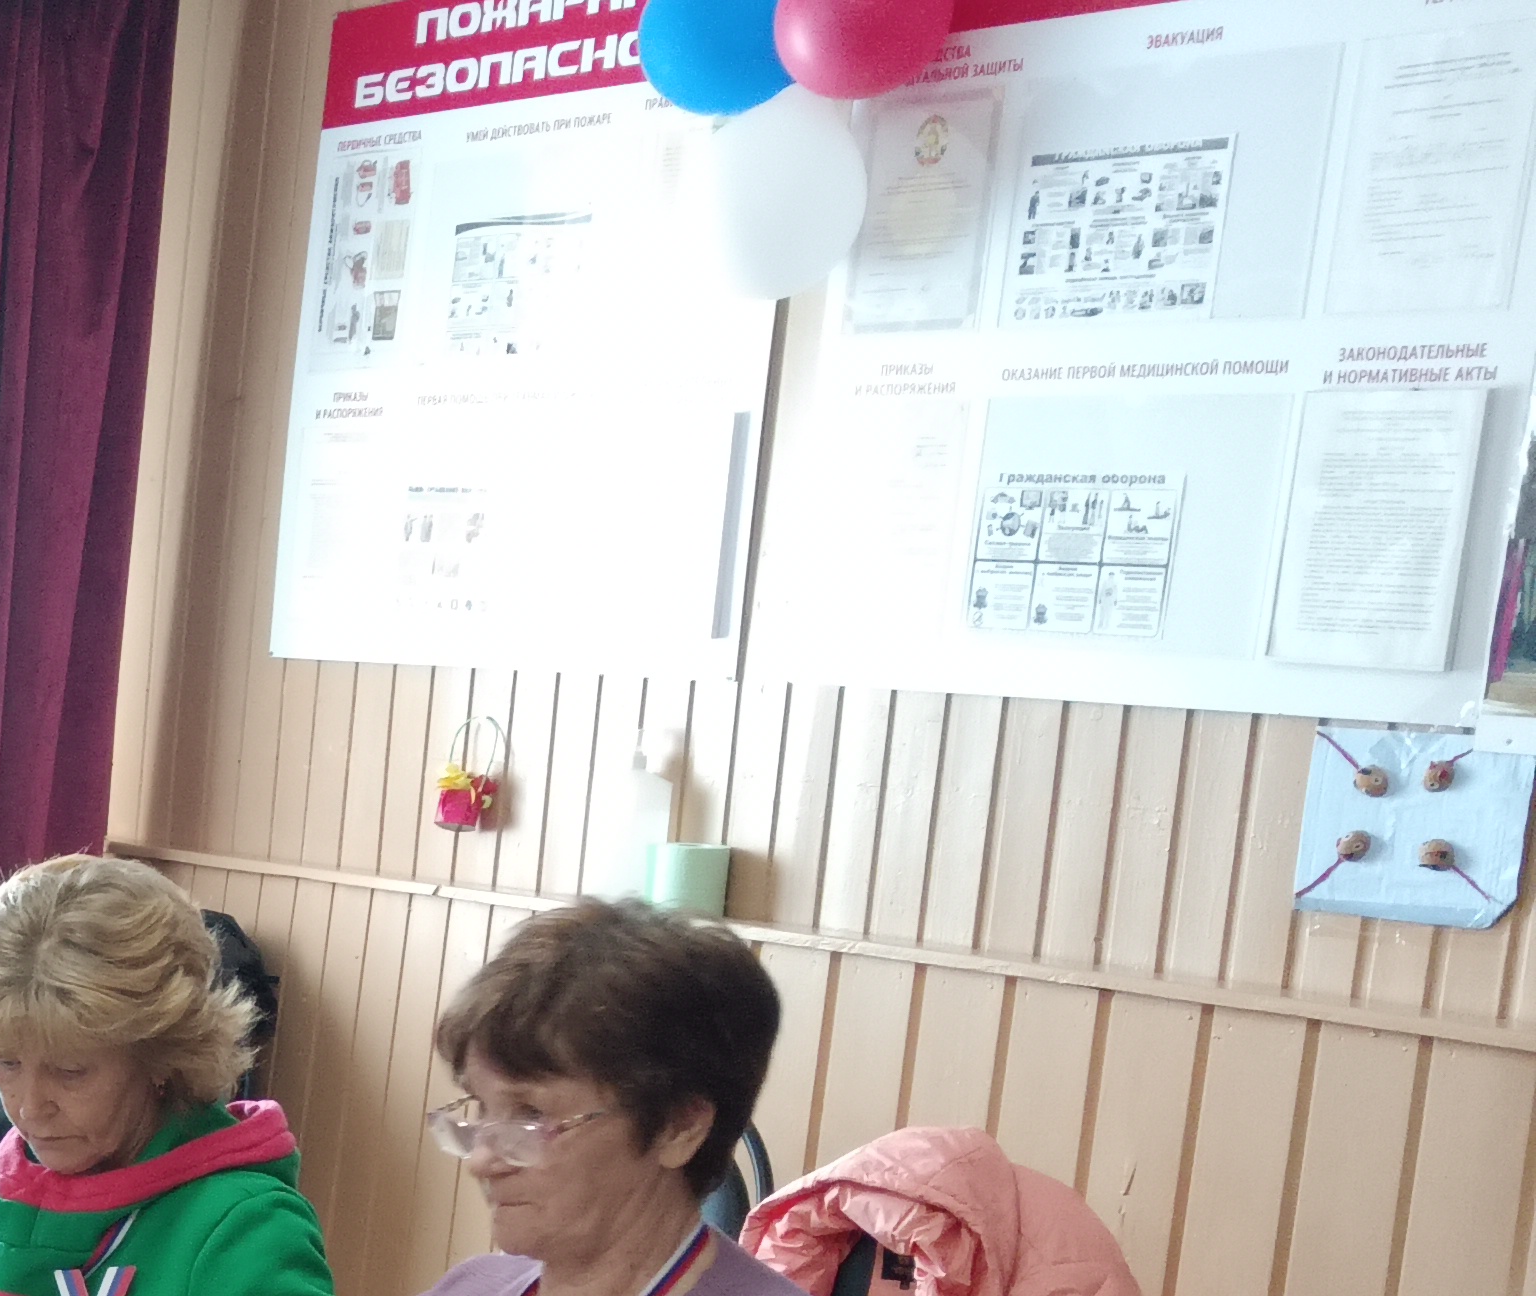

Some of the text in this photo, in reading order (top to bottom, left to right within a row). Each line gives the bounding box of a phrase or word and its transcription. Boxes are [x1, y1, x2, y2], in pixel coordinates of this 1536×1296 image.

[1146, 26, 1224, 49] ЭВАКУАЦИЯ
[973, 58, 1024, 77] ЗАЩИТЫ
[466, 112, 613, 143] УМЕЙ ДЕЙСТВОВАТЬ ПРИ ПОЖАРЕ
[384, 130, 422, 145] СРЕДСТВА
[1338, 343, 1488, 363] ЗАКОНОДАТЕЛЬНЫЕ
[880, 362, 934, 378] ПРИКАЗЫ
[1001, 359, 1290, 382] ОКАЗАНИЕ ПЕРВОЙ МЕДИЦИНСКОЙ ПОМОЩИ
[1322, 365, 1498, 385] И НОРМАТИВНЫЕ АКТЫ
[333, 391, 369, 403] ПРИКАЗЫ
[855, 381, 956, 398] И РАСПОРЯЖЕНИЯ
[315, 407, 383, 420] И РАСПОРЯЖЕНИЯ
[999, 472, 1166, 487] Гражданская оборона
